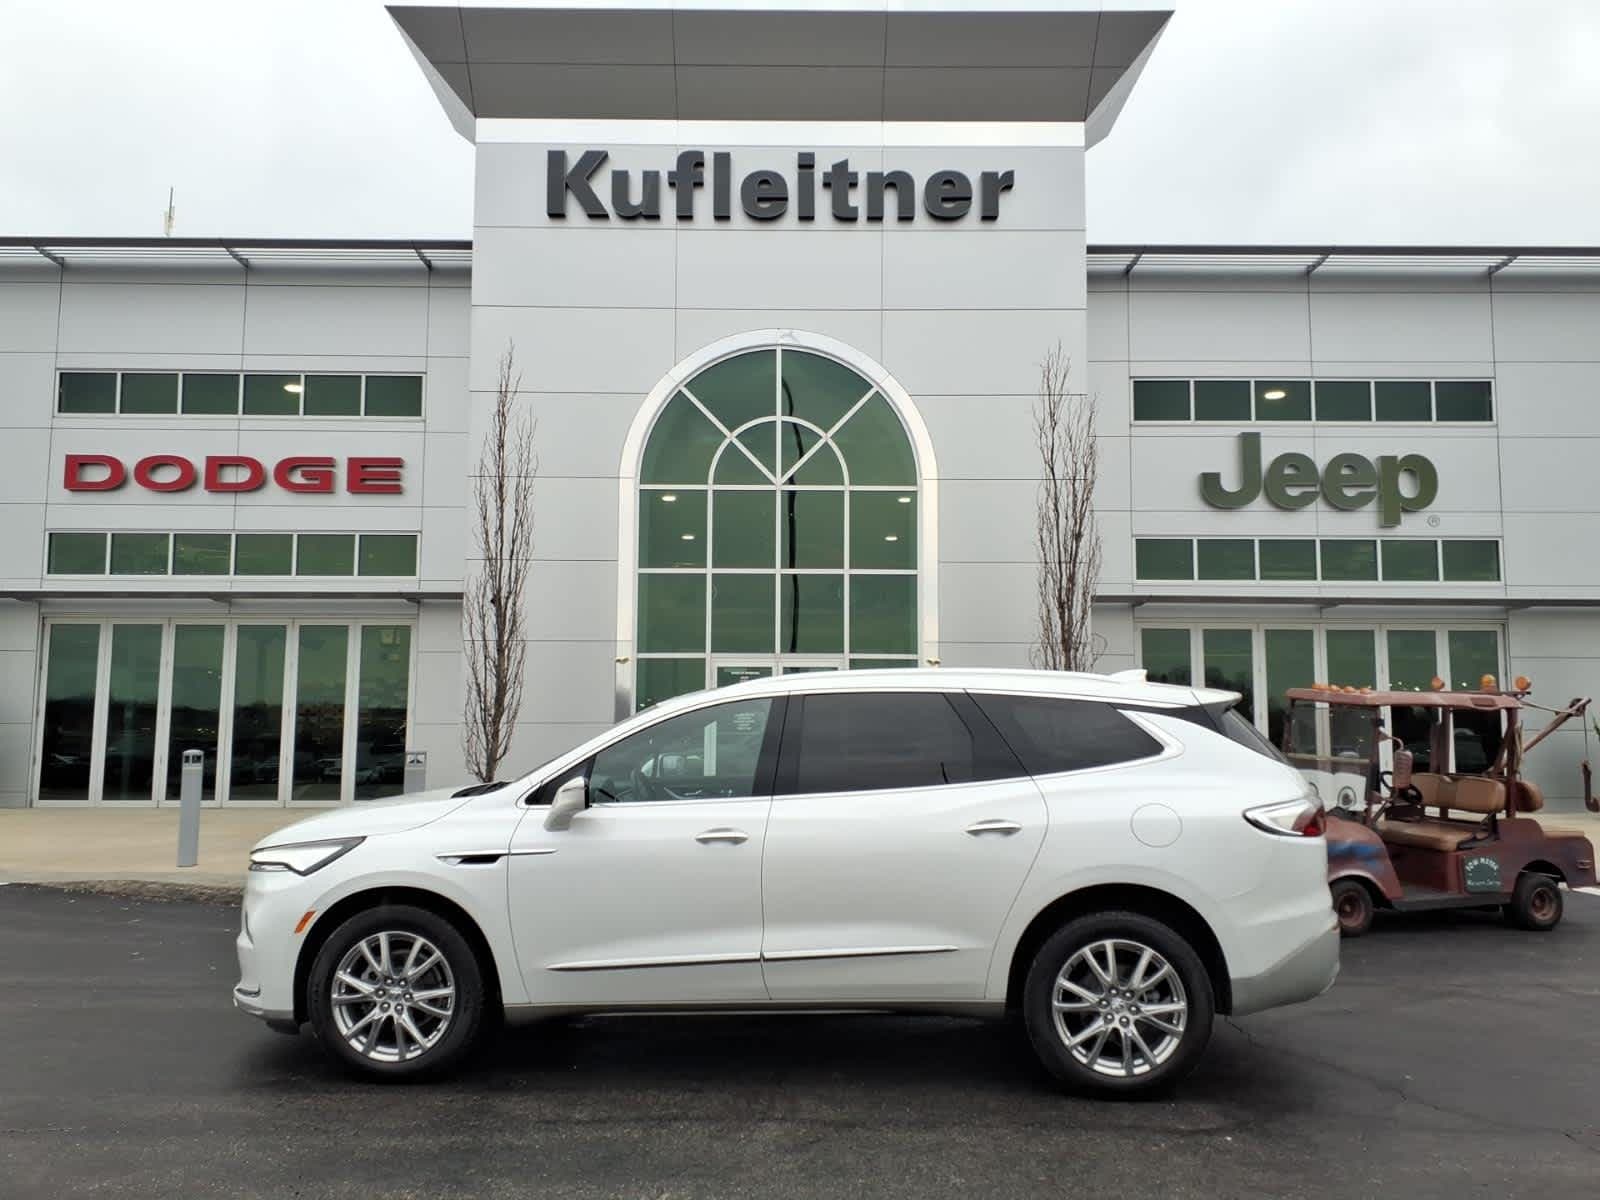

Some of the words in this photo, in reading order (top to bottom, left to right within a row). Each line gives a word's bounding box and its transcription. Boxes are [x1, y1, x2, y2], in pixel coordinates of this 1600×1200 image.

[547, 150, 1015, 223] Kufleitner
[64, 454, 405, 494] DODGE
[1199, 432, 1438, 528] Jeep
